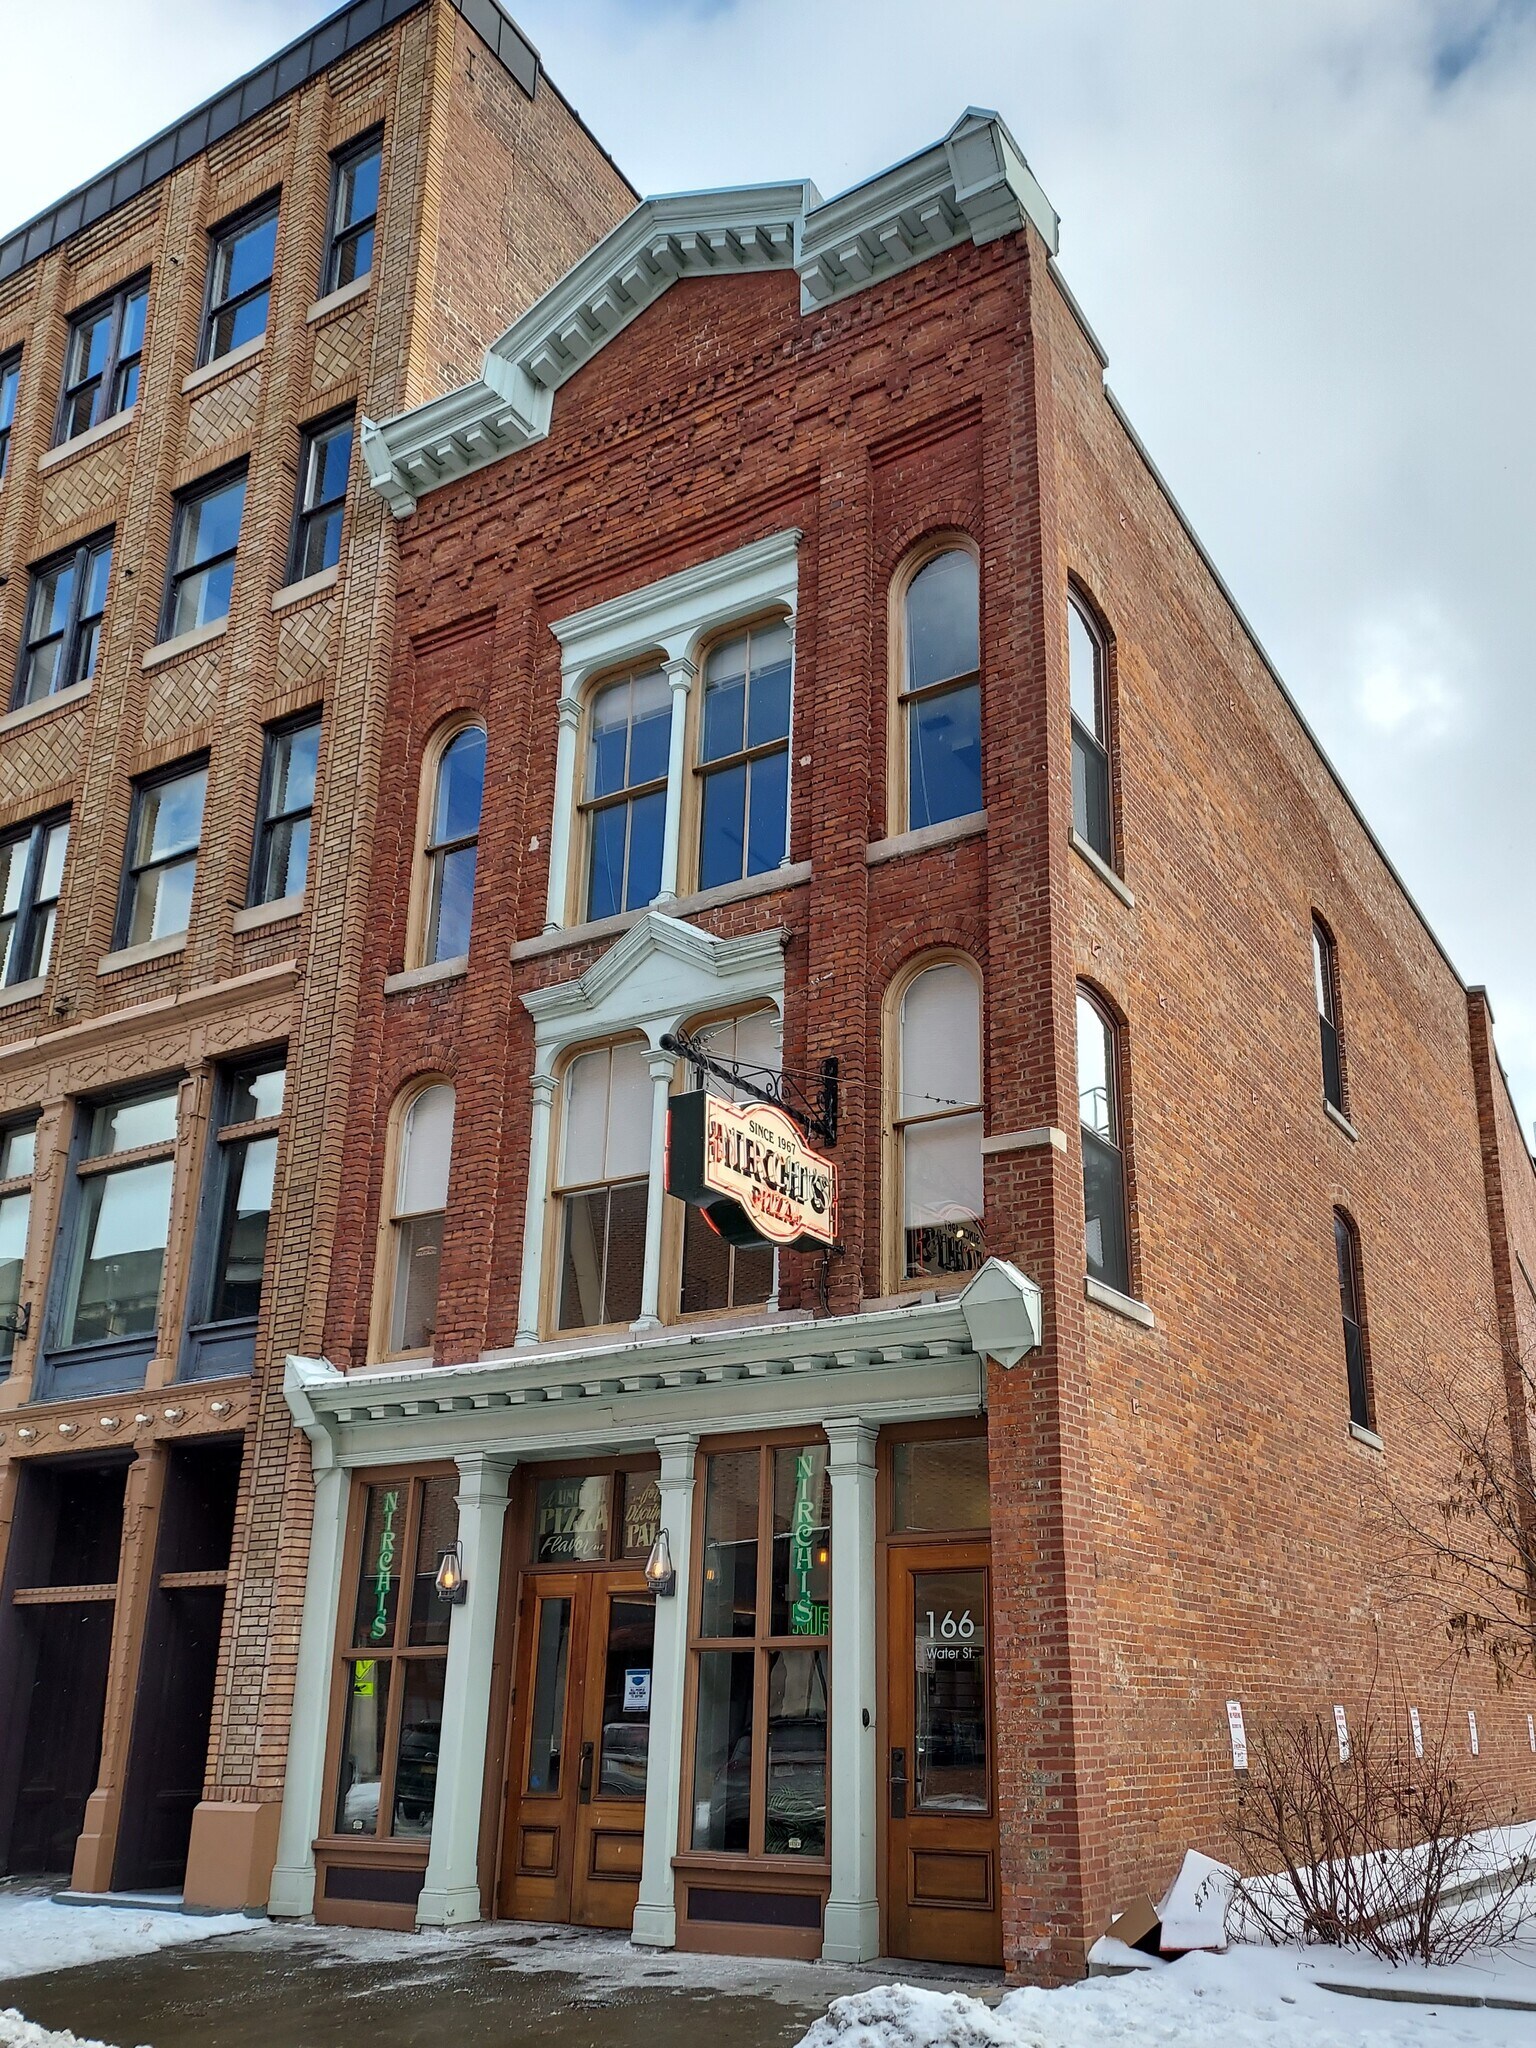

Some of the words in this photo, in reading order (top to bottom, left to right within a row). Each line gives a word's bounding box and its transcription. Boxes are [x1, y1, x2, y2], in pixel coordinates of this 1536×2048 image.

[749, 1120, 775, 1144] SINCE
[777, 1136, 796, 1154] 1967
[751, 1185, 800, 1226] PIZZA
[539, 1505, 607, 1534] PIZZA
[926, 1609, 975, 1638] 166
[926, 1647, 959, 1659] Water
[962, 1647, 976, 1659] St.
